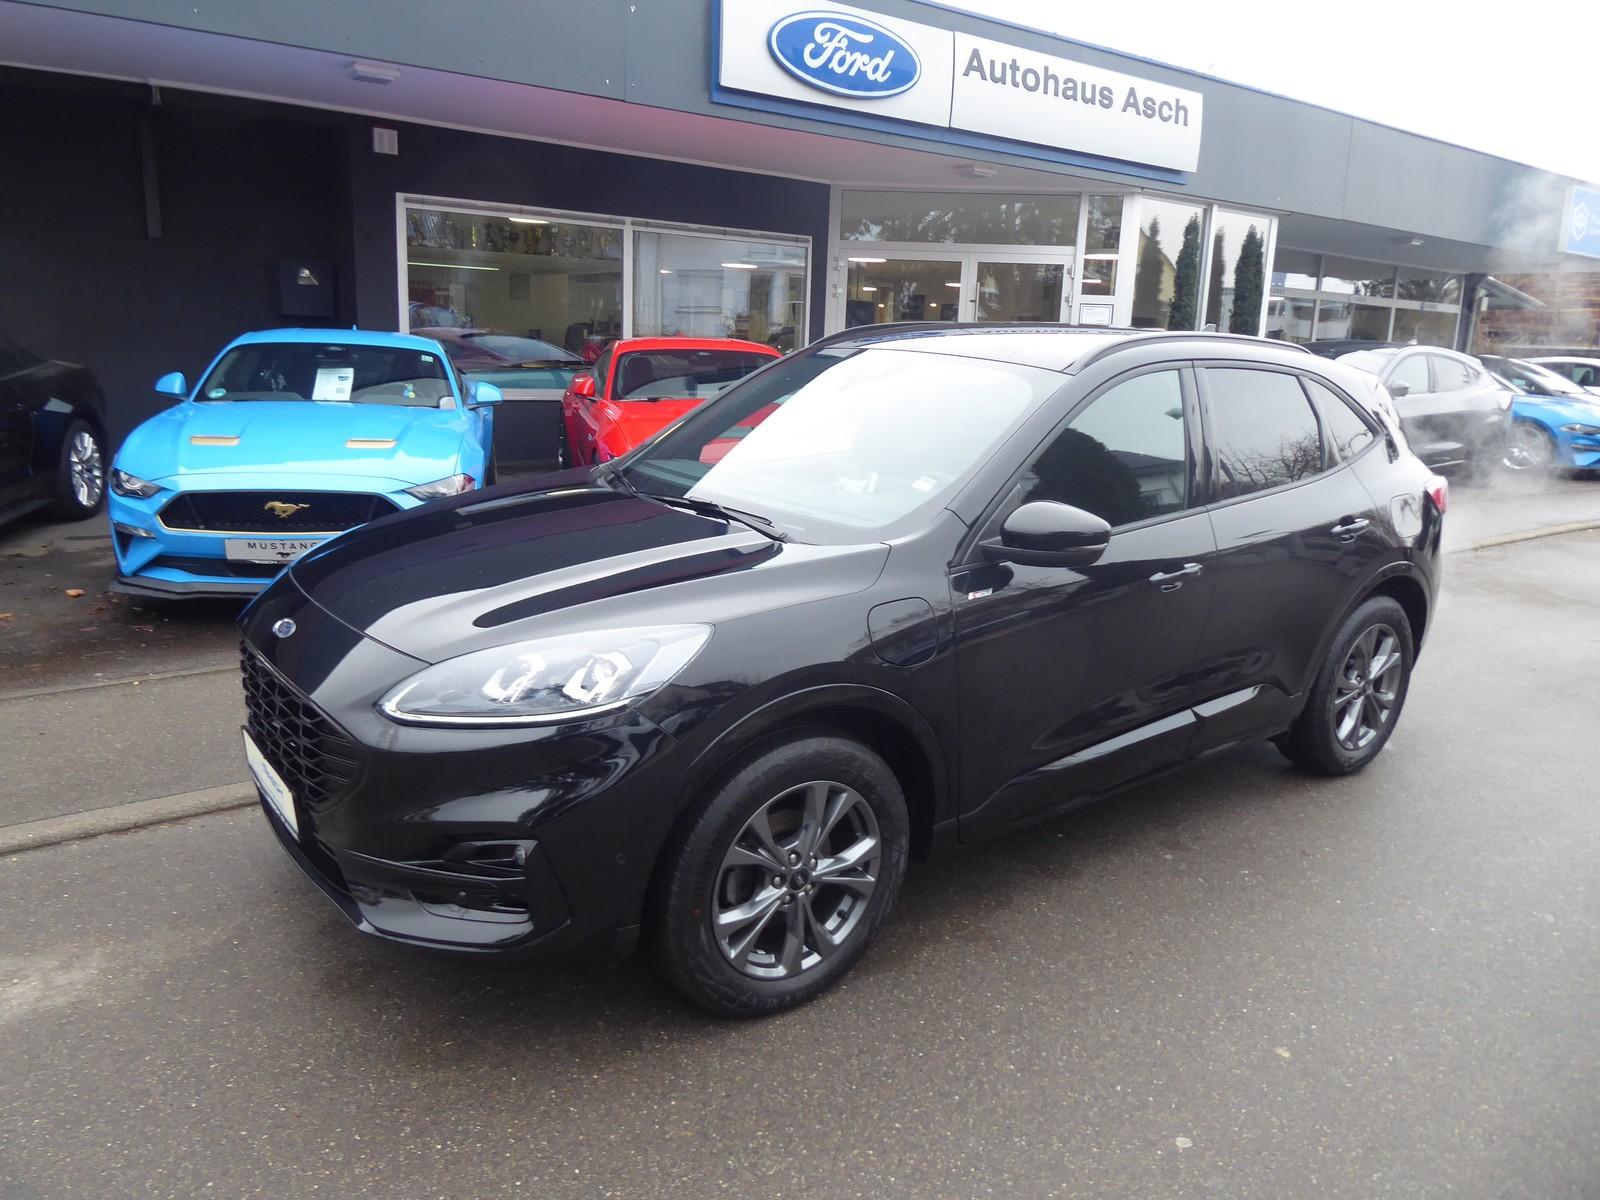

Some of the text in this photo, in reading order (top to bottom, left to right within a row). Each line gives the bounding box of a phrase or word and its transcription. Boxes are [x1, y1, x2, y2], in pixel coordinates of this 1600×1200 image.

[803, 21, 895, 83] Ford
[963, 47, 1189, 127] Autohaus Asch
